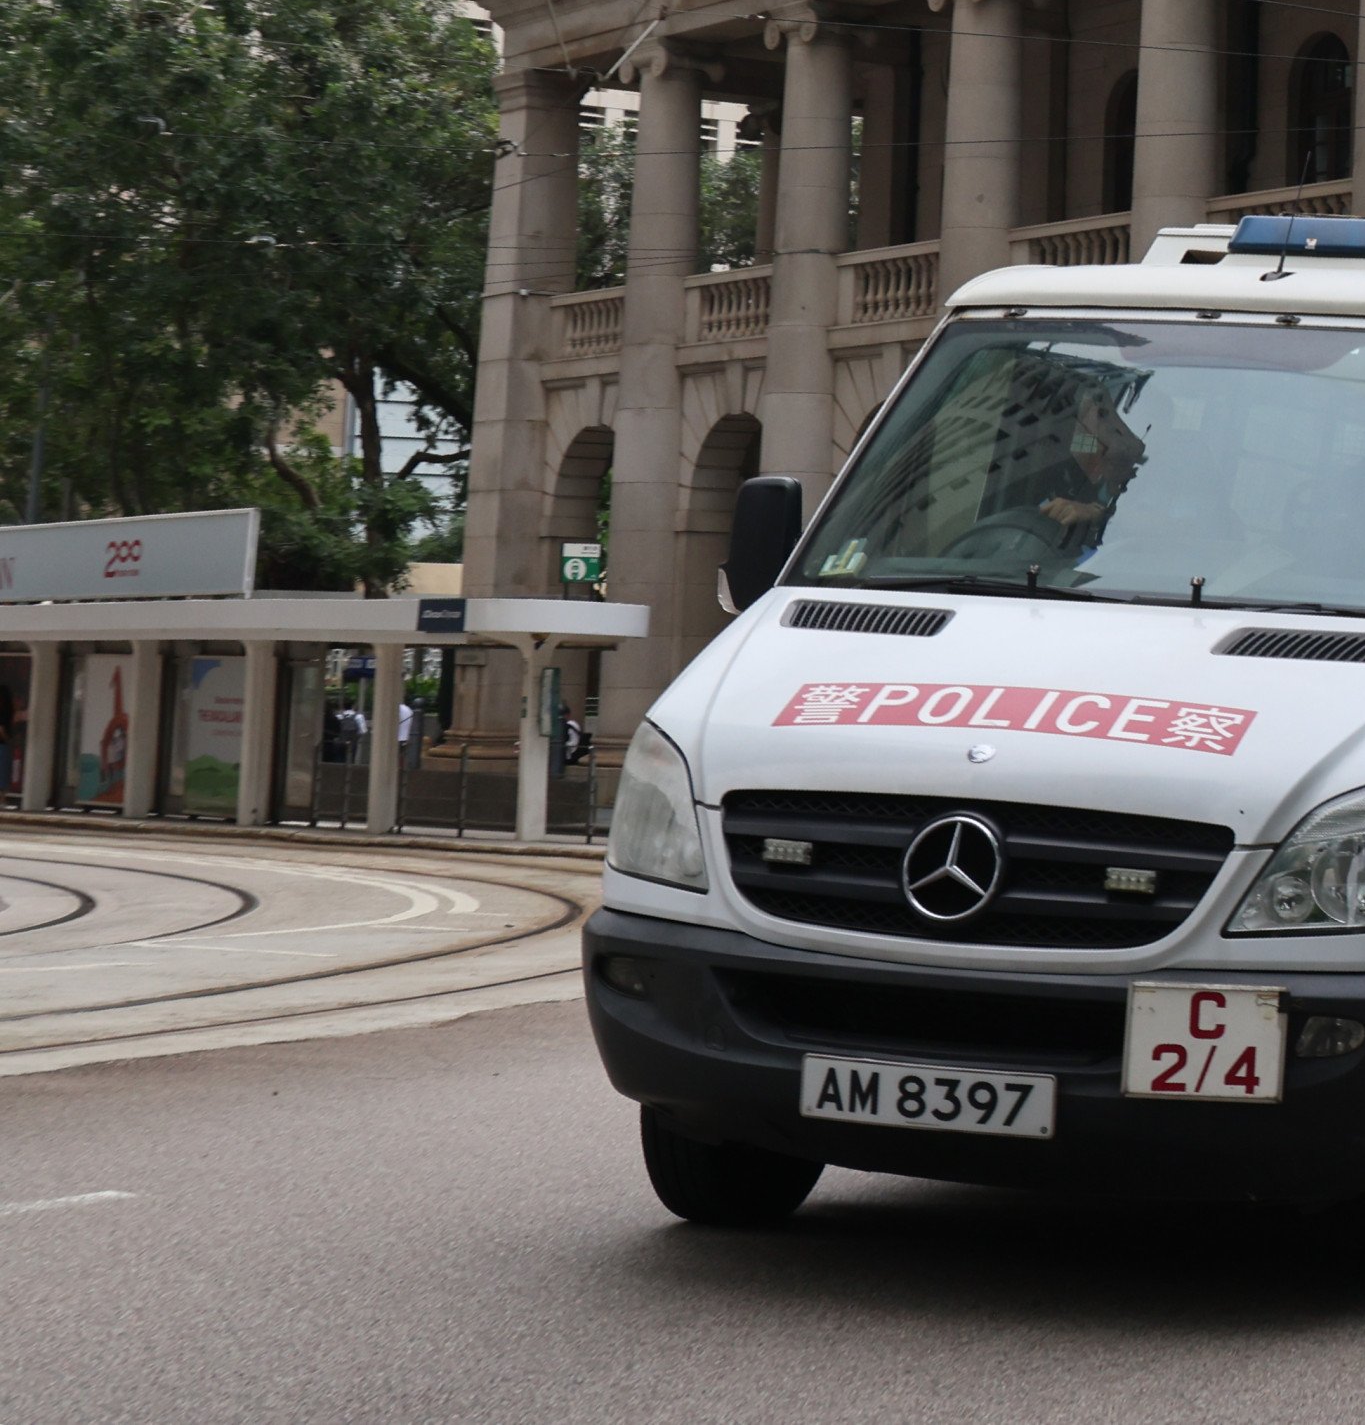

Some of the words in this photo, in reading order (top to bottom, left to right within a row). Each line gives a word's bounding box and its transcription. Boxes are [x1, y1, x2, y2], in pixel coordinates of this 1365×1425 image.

[793, 685, 868, 724] 警
[857, 684, 1170, 743] POLICE
[1161, 706, 1243, 751] 察
[1189, 991, 1227, 1040] C
[1151, 1043, 1260, 1095] 2/4
[816, 1067, 879, 1115] AM
[896, 1075, 1035, 1128] 8397
